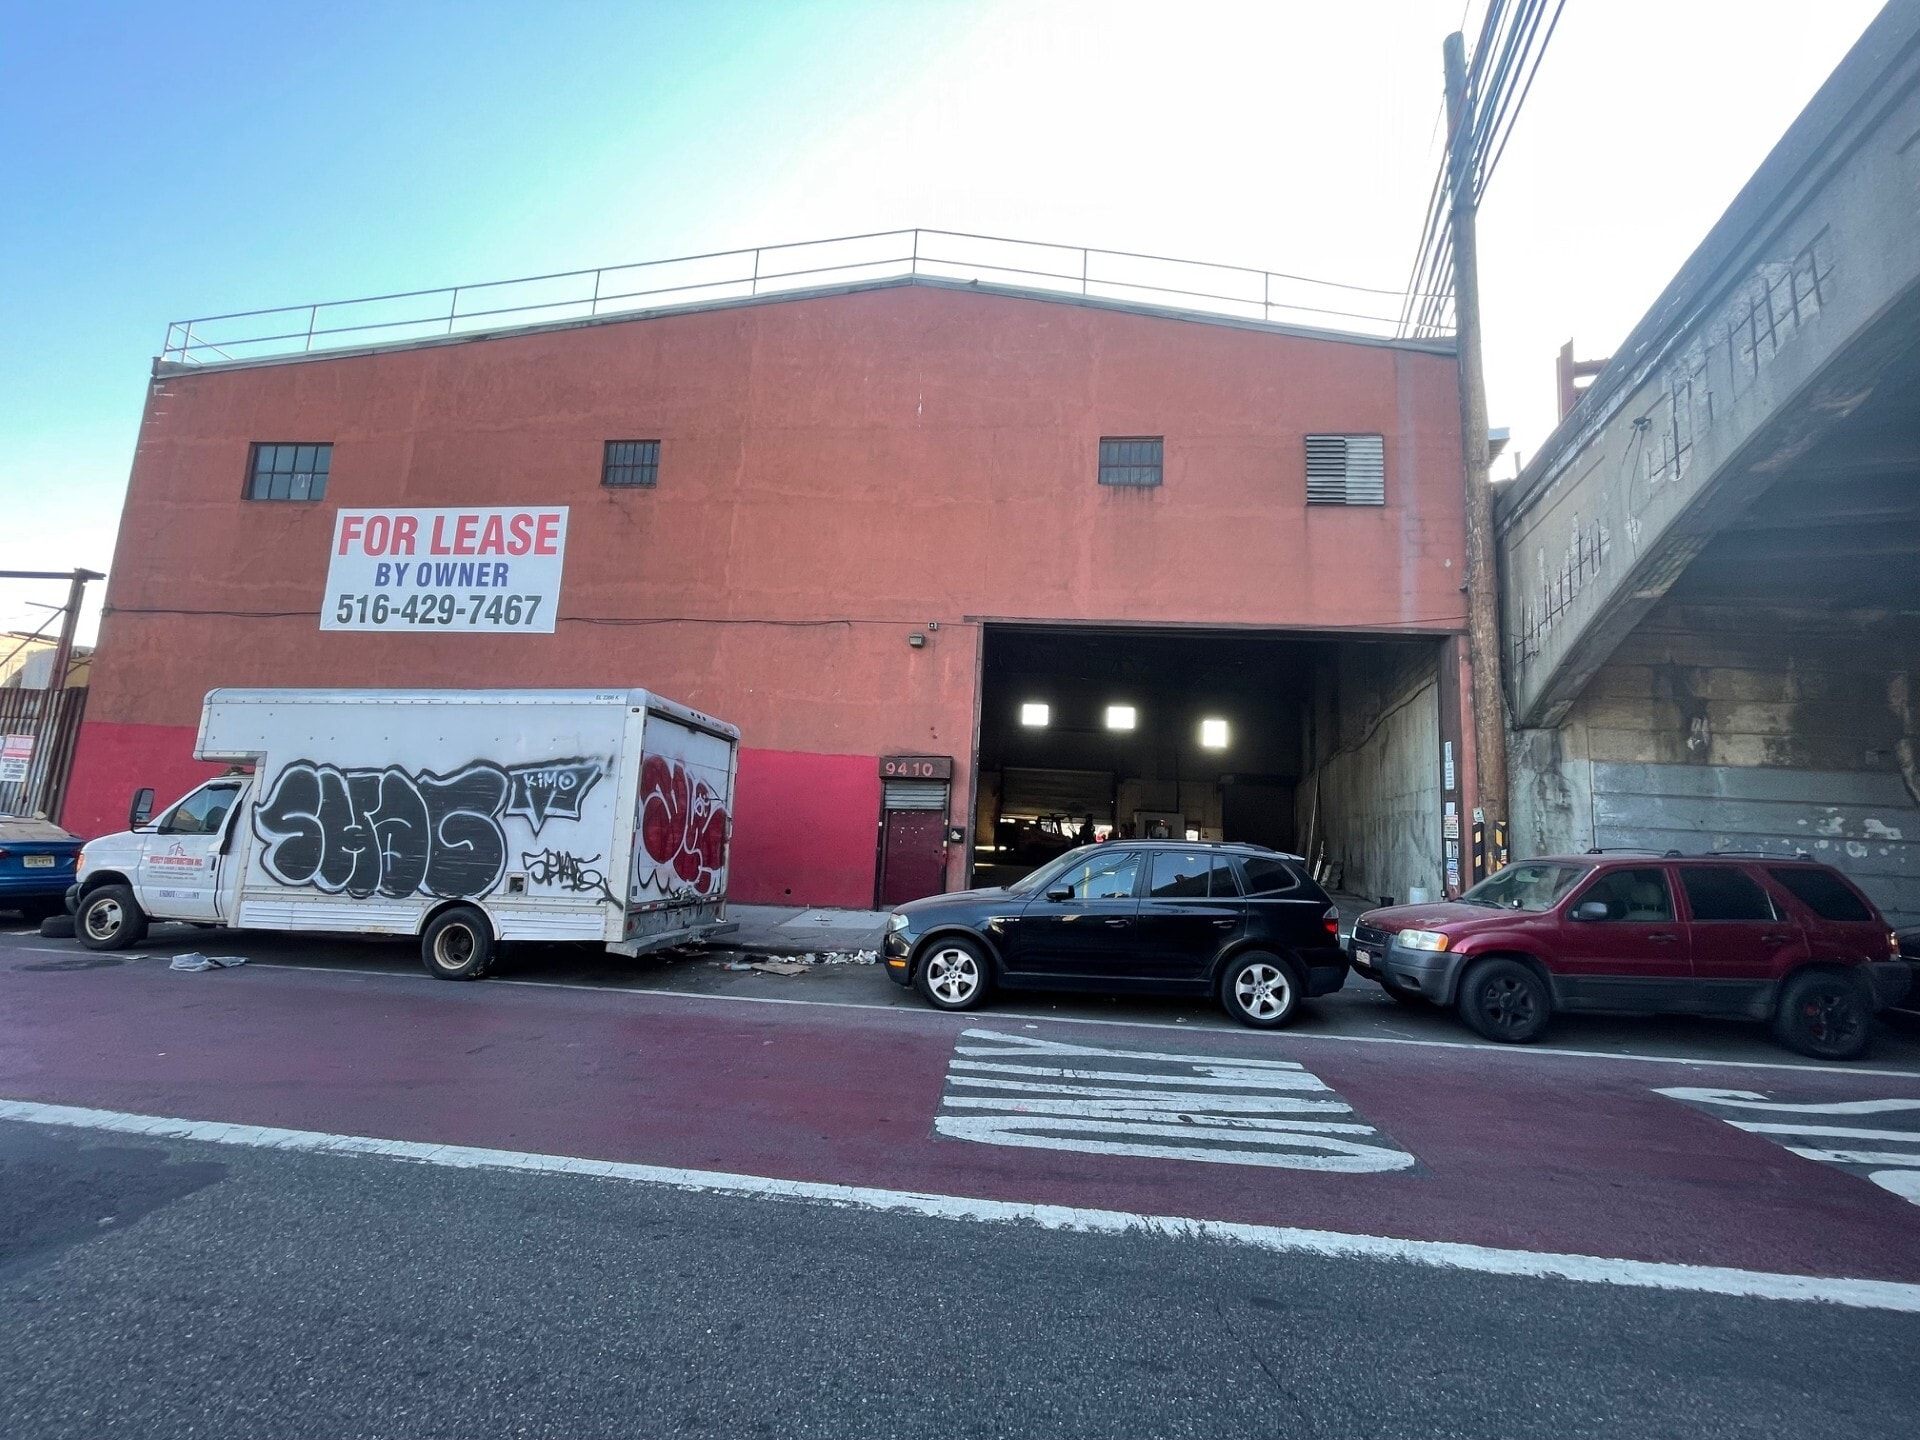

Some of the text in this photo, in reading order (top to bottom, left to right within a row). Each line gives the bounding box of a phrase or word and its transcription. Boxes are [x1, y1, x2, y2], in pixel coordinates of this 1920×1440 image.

[338, 513, 561, 557] FOR LEASE
[375, 562, 509, 587] BY OWNER
[336, 593, 542, 625] 516-429-7467
[885, 761, 934, 777] 9410
